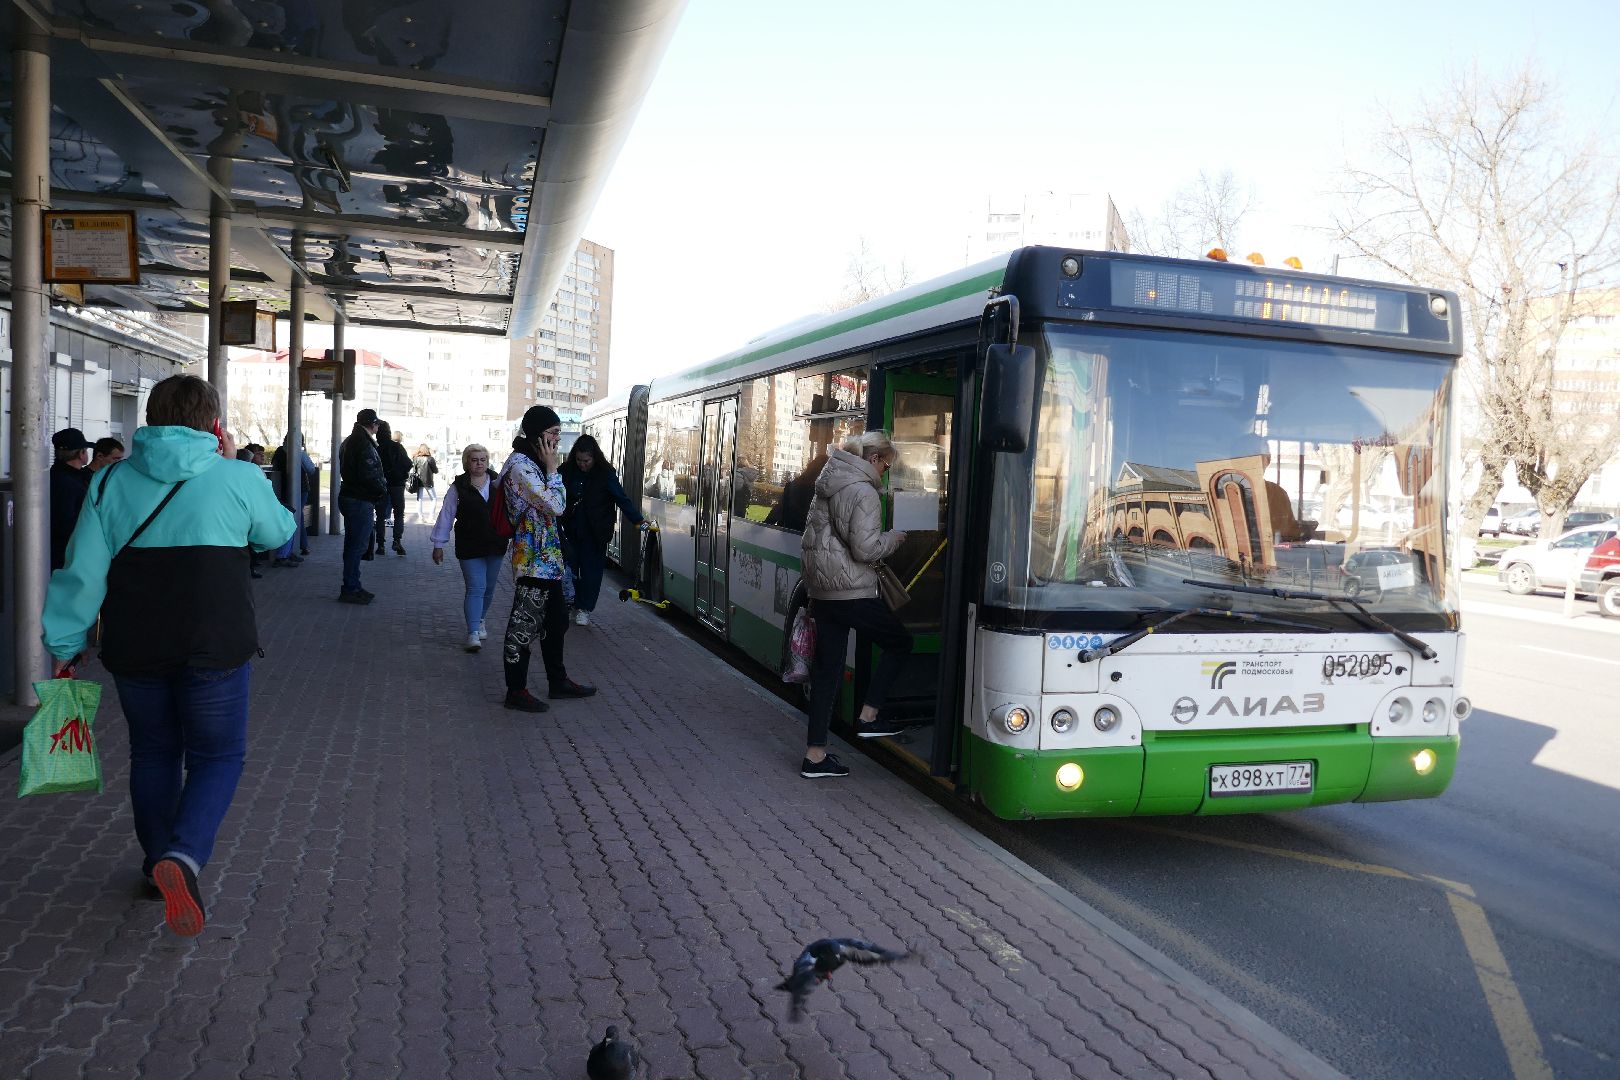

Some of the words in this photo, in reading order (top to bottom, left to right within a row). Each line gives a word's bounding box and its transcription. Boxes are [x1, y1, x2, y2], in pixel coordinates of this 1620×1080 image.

[1241, 668, 1294, 676] ПОДМОСКОВЬЯ
[1324, 653, 1393, 678] 052095
[1206, 692, 1325, 717] ЛИАЗ
